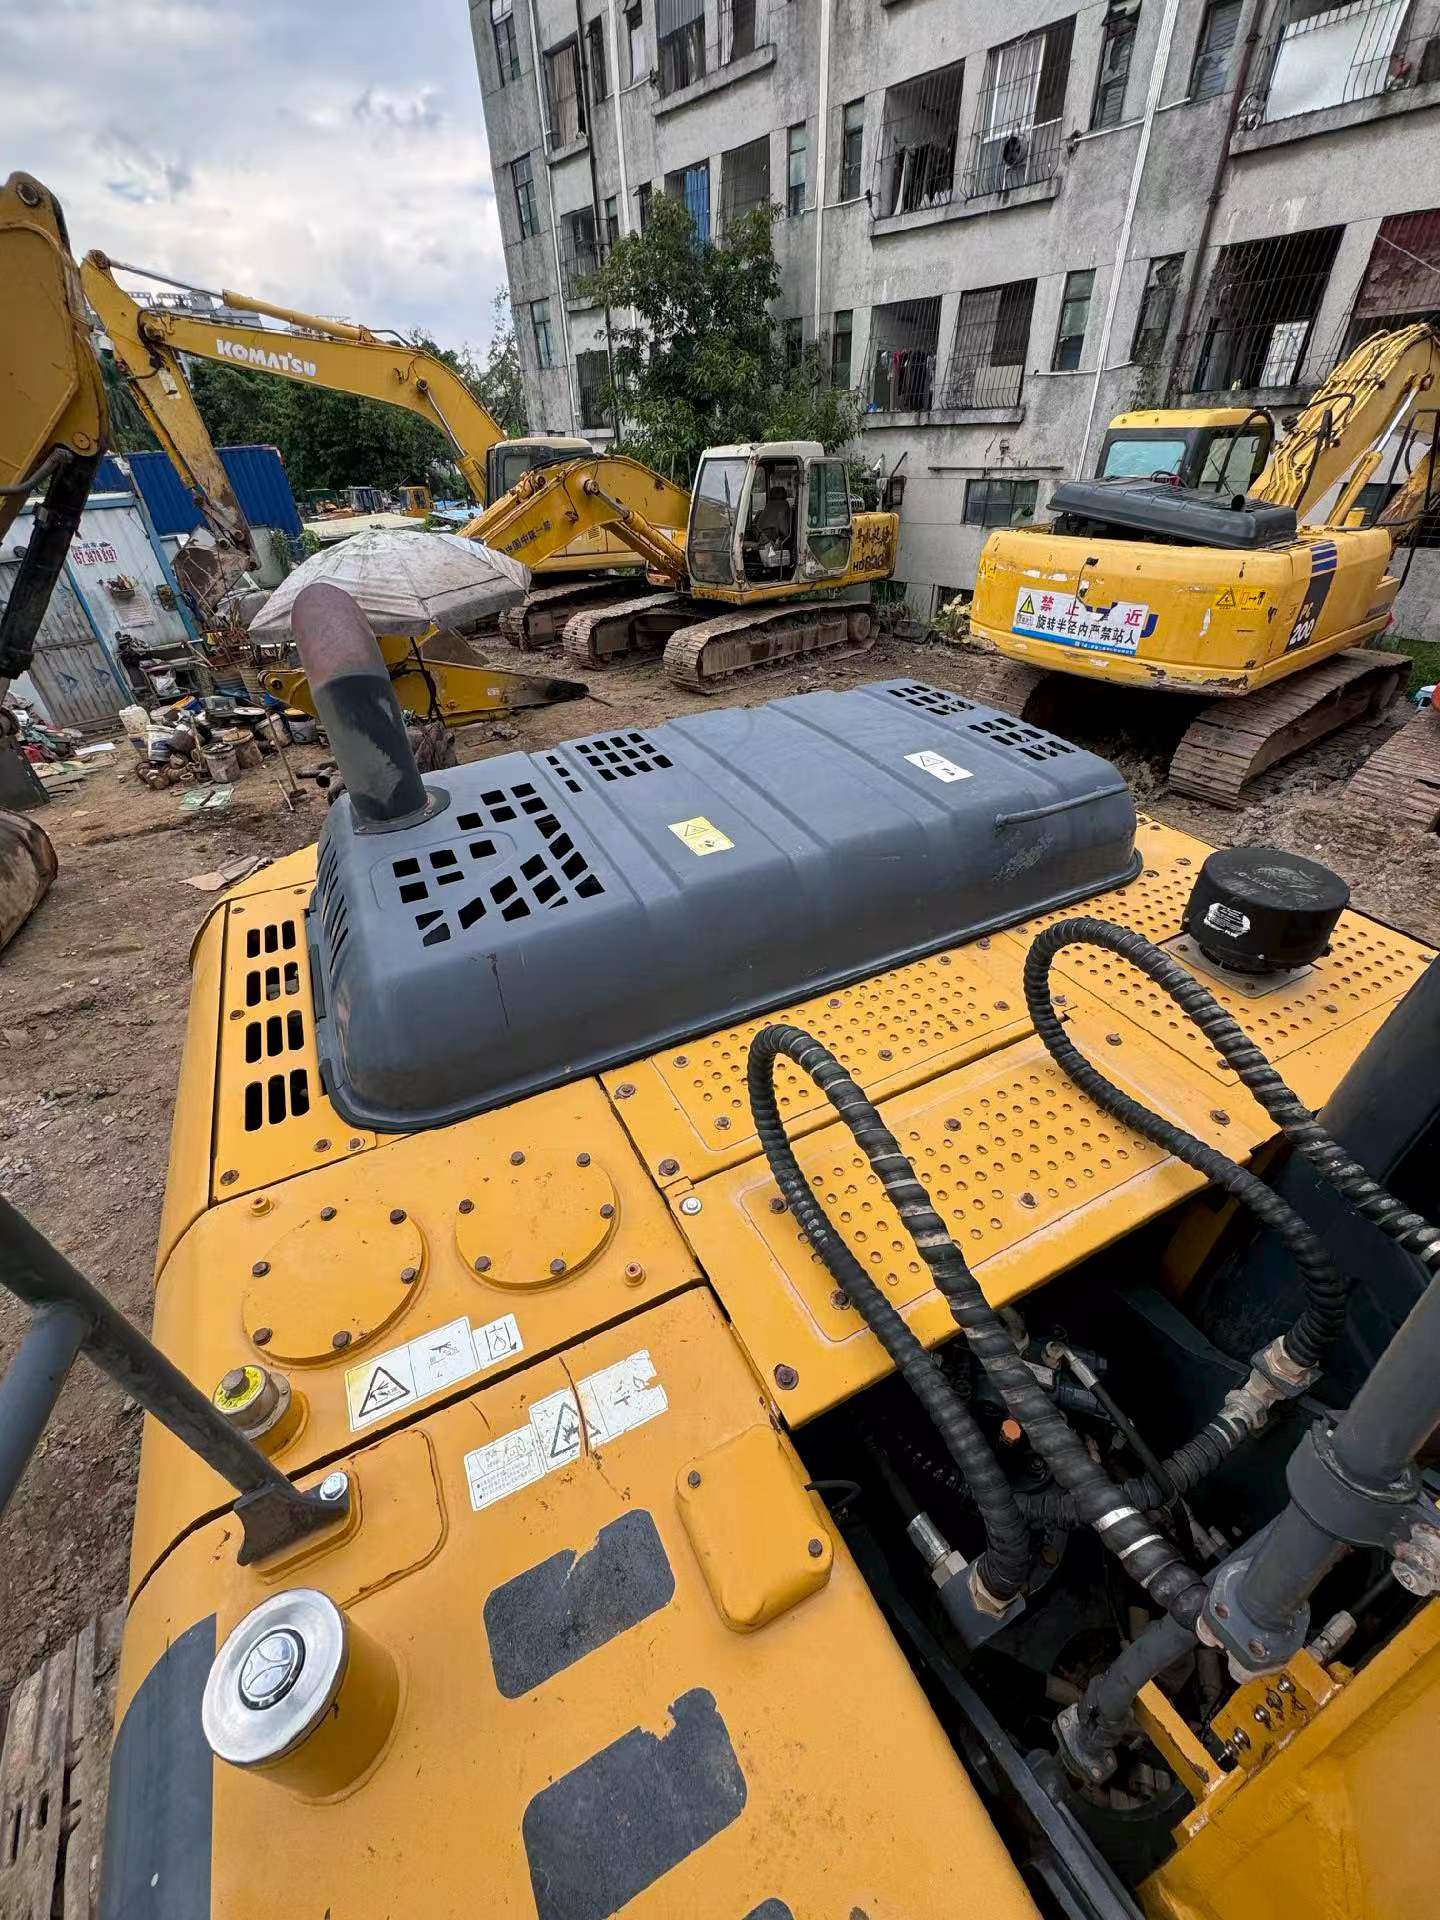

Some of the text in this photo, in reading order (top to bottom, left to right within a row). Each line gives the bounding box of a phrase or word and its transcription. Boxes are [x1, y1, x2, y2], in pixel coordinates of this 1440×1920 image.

[216, 338, 317, 377] KOMATSU
[1040, 595, 1142, 627] 禁止近
[1035, 614, 1136, 645] 旋转半径内严禁站人
[1289, 618, 1316, 646] 200
